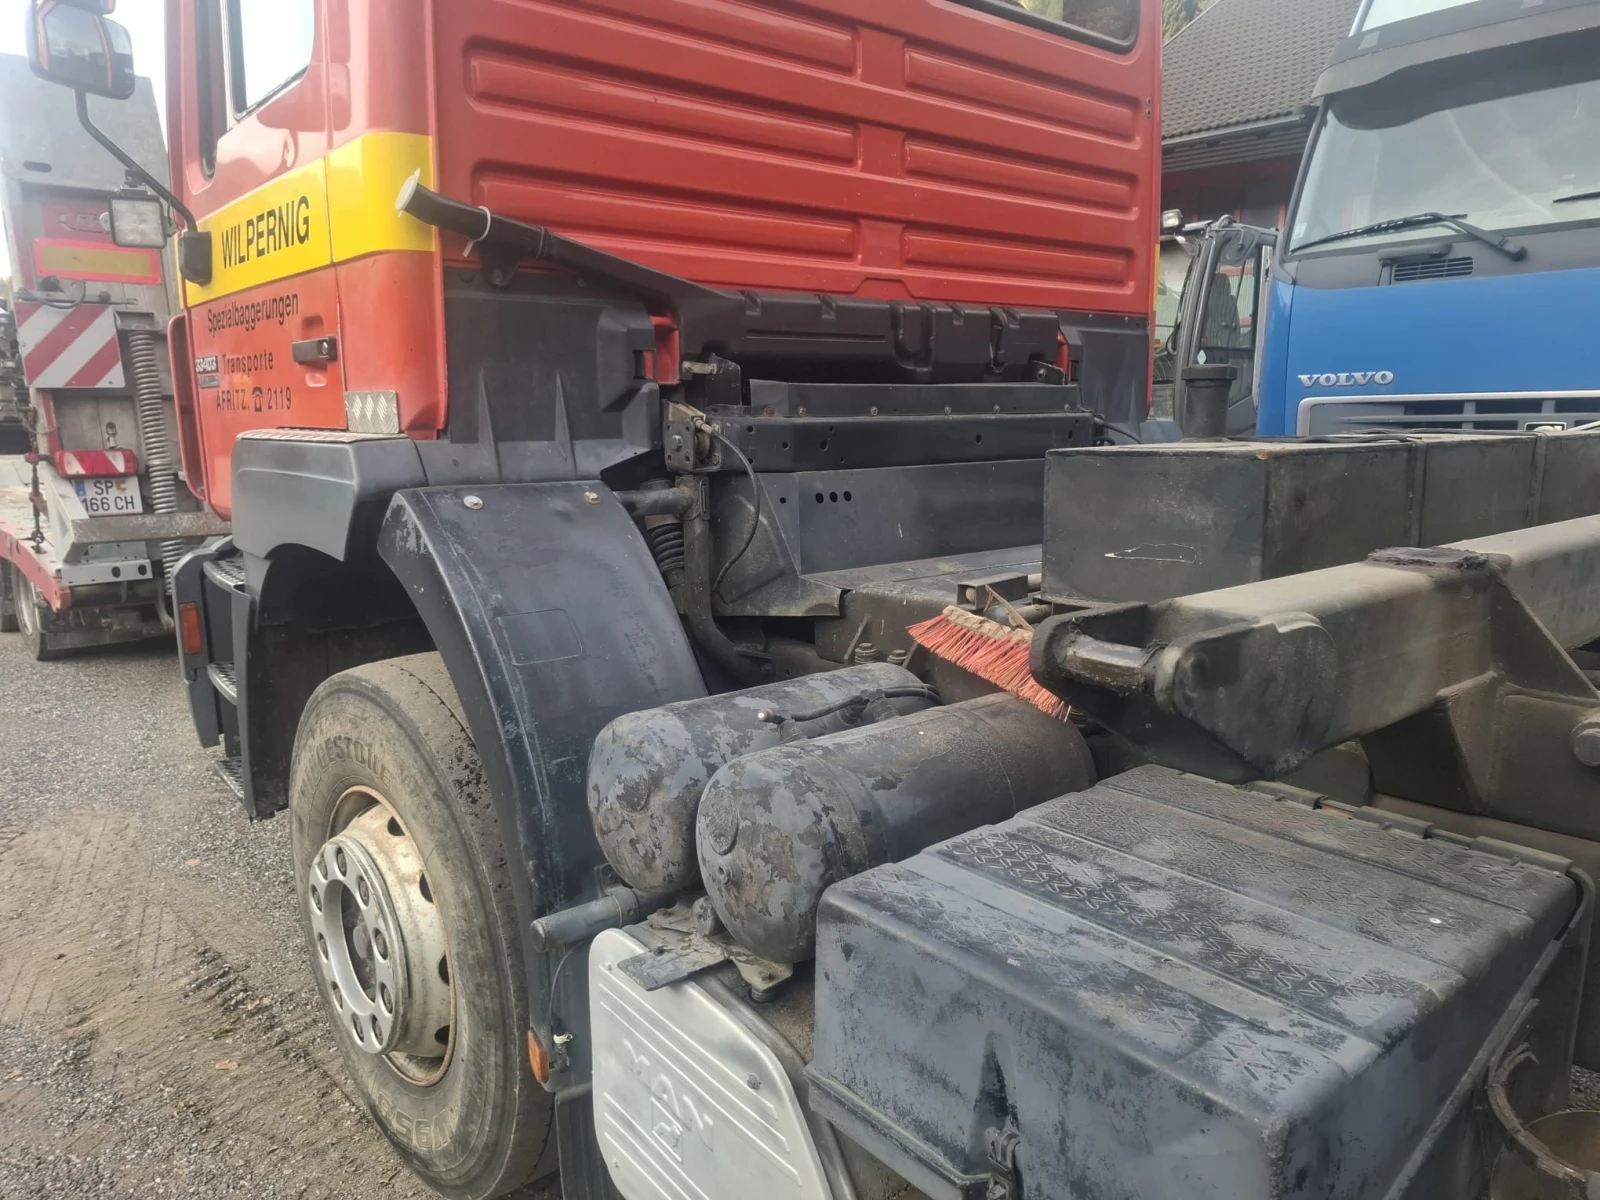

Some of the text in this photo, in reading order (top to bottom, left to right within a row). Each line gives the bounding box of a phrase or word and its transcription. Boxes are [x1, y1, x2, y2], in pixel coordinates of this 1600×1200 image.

[221, 195, 310, 269] WILPERNIG
[207, 293, 299, 337] Spezialbaggerungen
[221, 349, 274, 377] Transporte
[1298, 370, 1394, 388] VOLVO
[266, 386, 292, 410] 2119
[93, 479, 114, 496] SP
[82, 495, 135, 513] 166 CH
